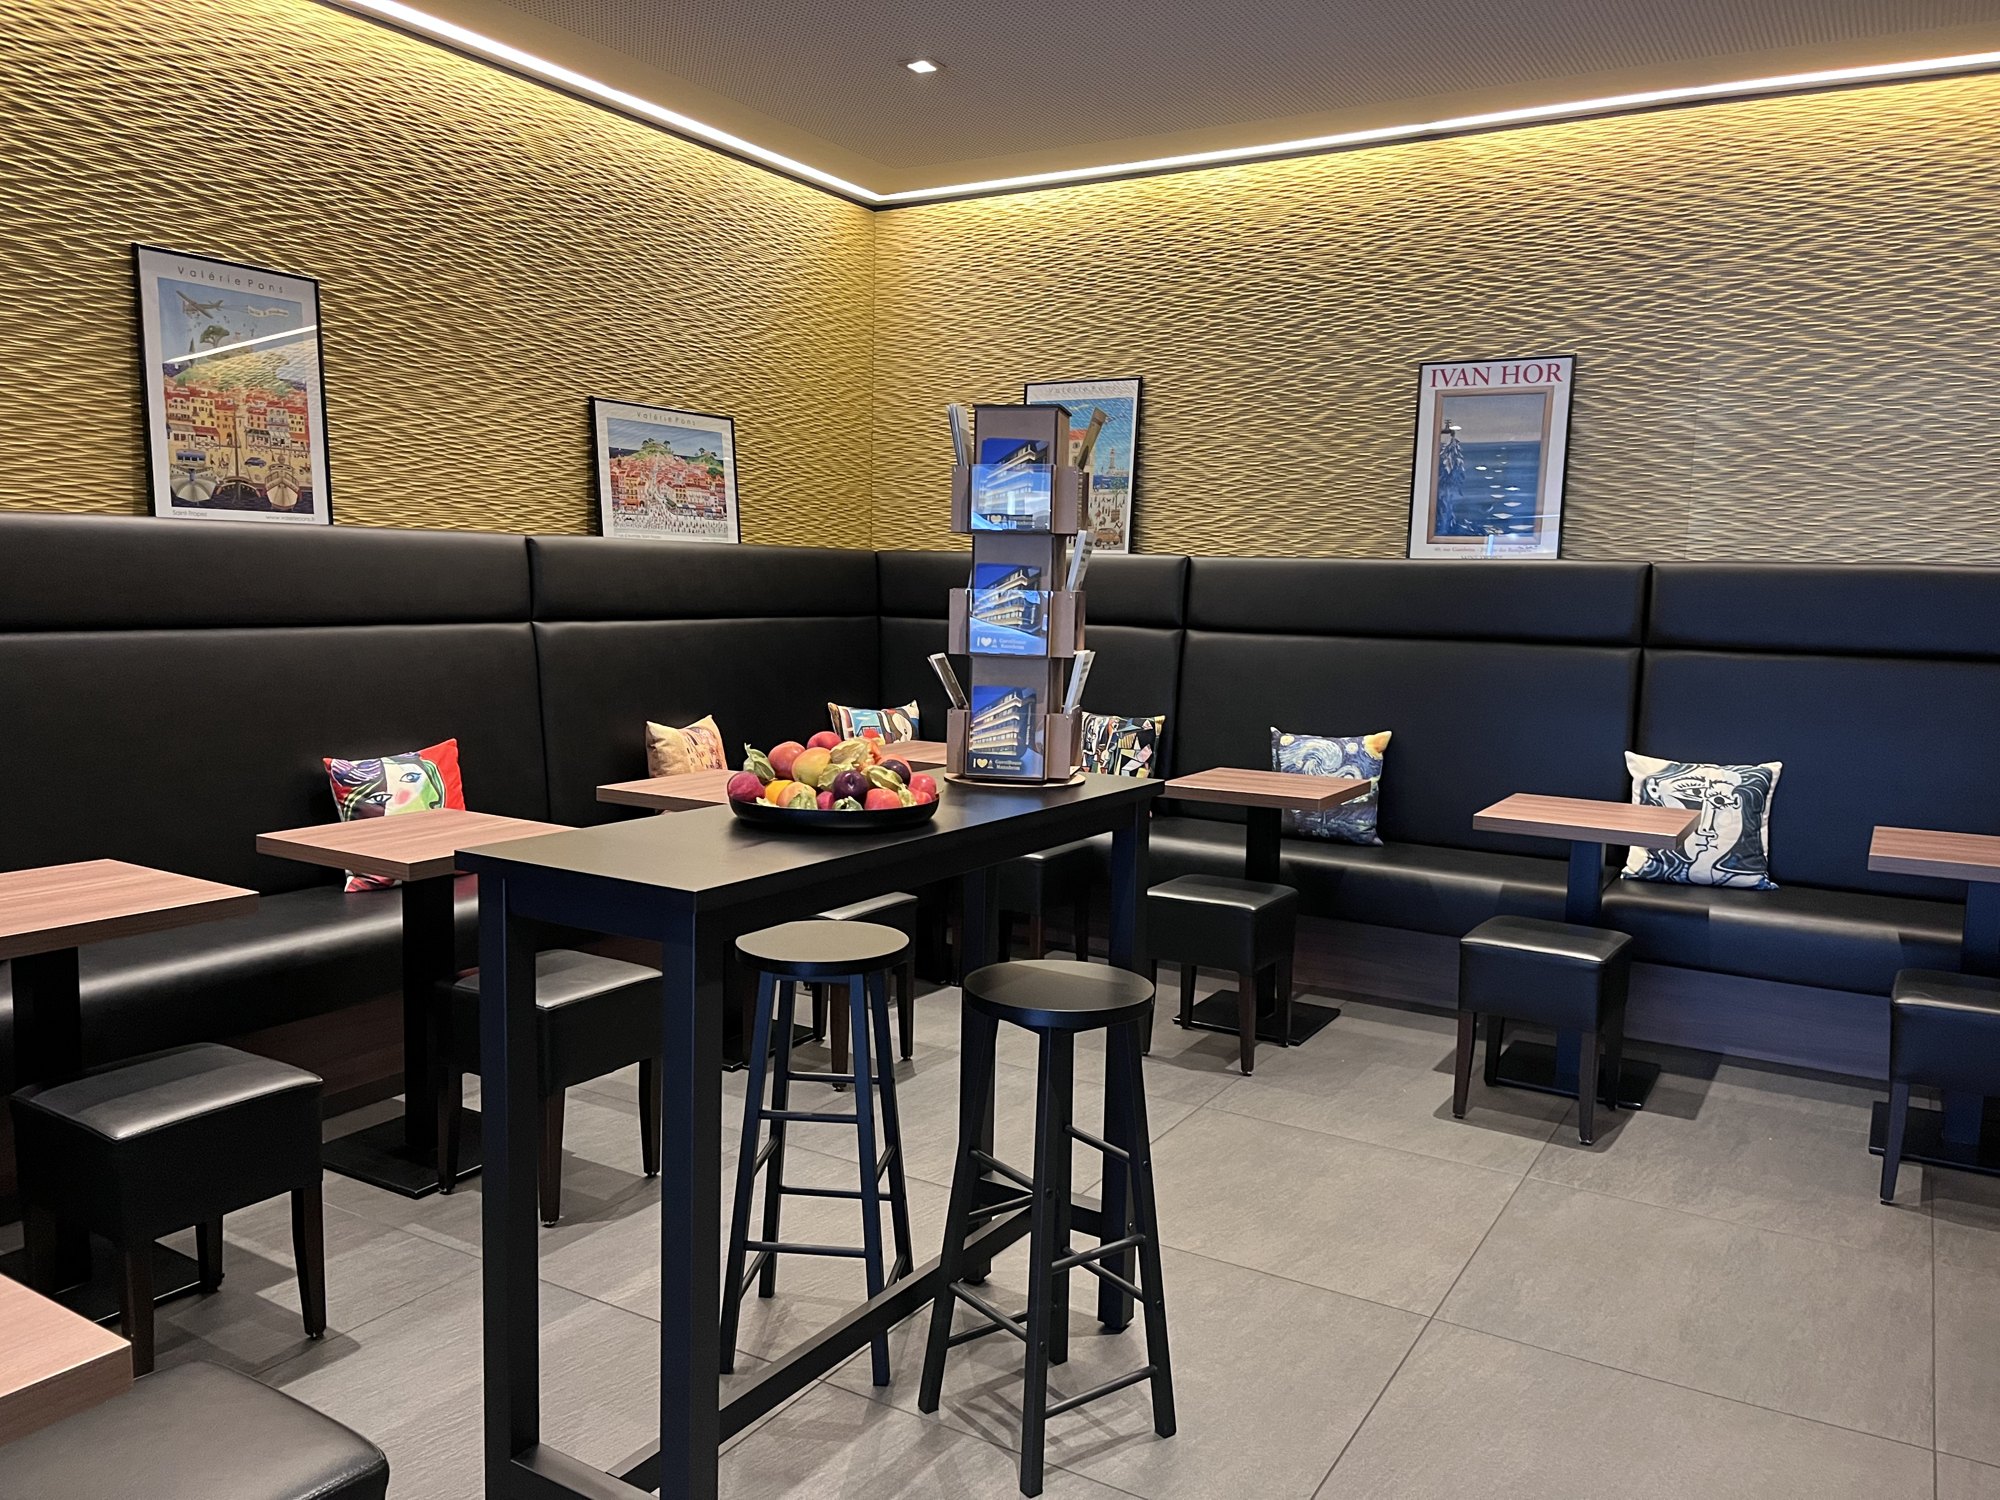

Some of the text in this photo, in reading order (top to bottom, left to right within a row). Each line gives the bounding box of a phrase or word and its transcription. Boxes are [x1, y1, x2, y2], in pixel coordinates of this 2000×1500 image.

[177, 265, 284, 294] Valérie Pons
[1430, 363, 1563, 388] IVAN HOR
